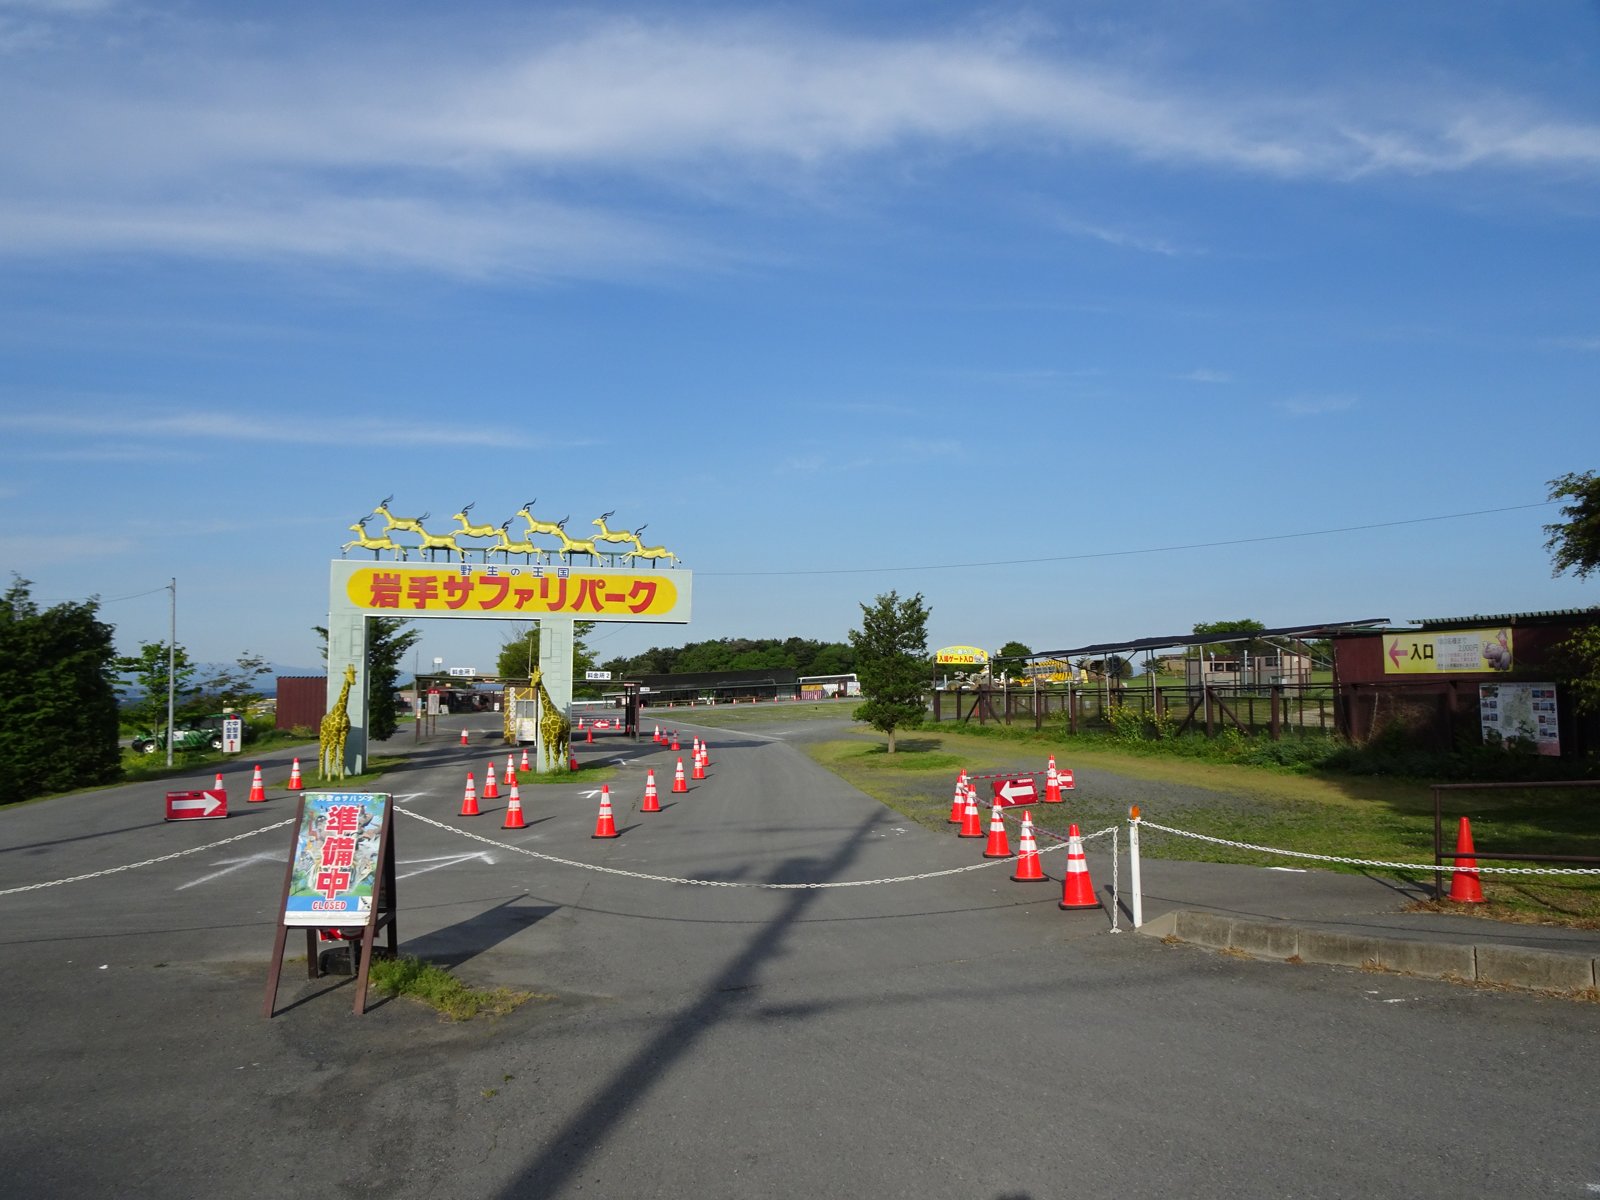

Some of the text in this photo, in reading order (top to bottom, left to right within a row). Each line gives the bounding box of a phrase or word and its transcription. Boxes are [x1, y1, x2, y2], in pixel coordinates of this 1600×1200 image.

[460, 564, 570, 579] 野生の王国
[369, 572, 658, 615] 岩手サファリパーク
[1410, 643, 1434, 661] 入口
[315, 804, 360, 900] 準備中
[311, 900, 347, 911] CLOSED
